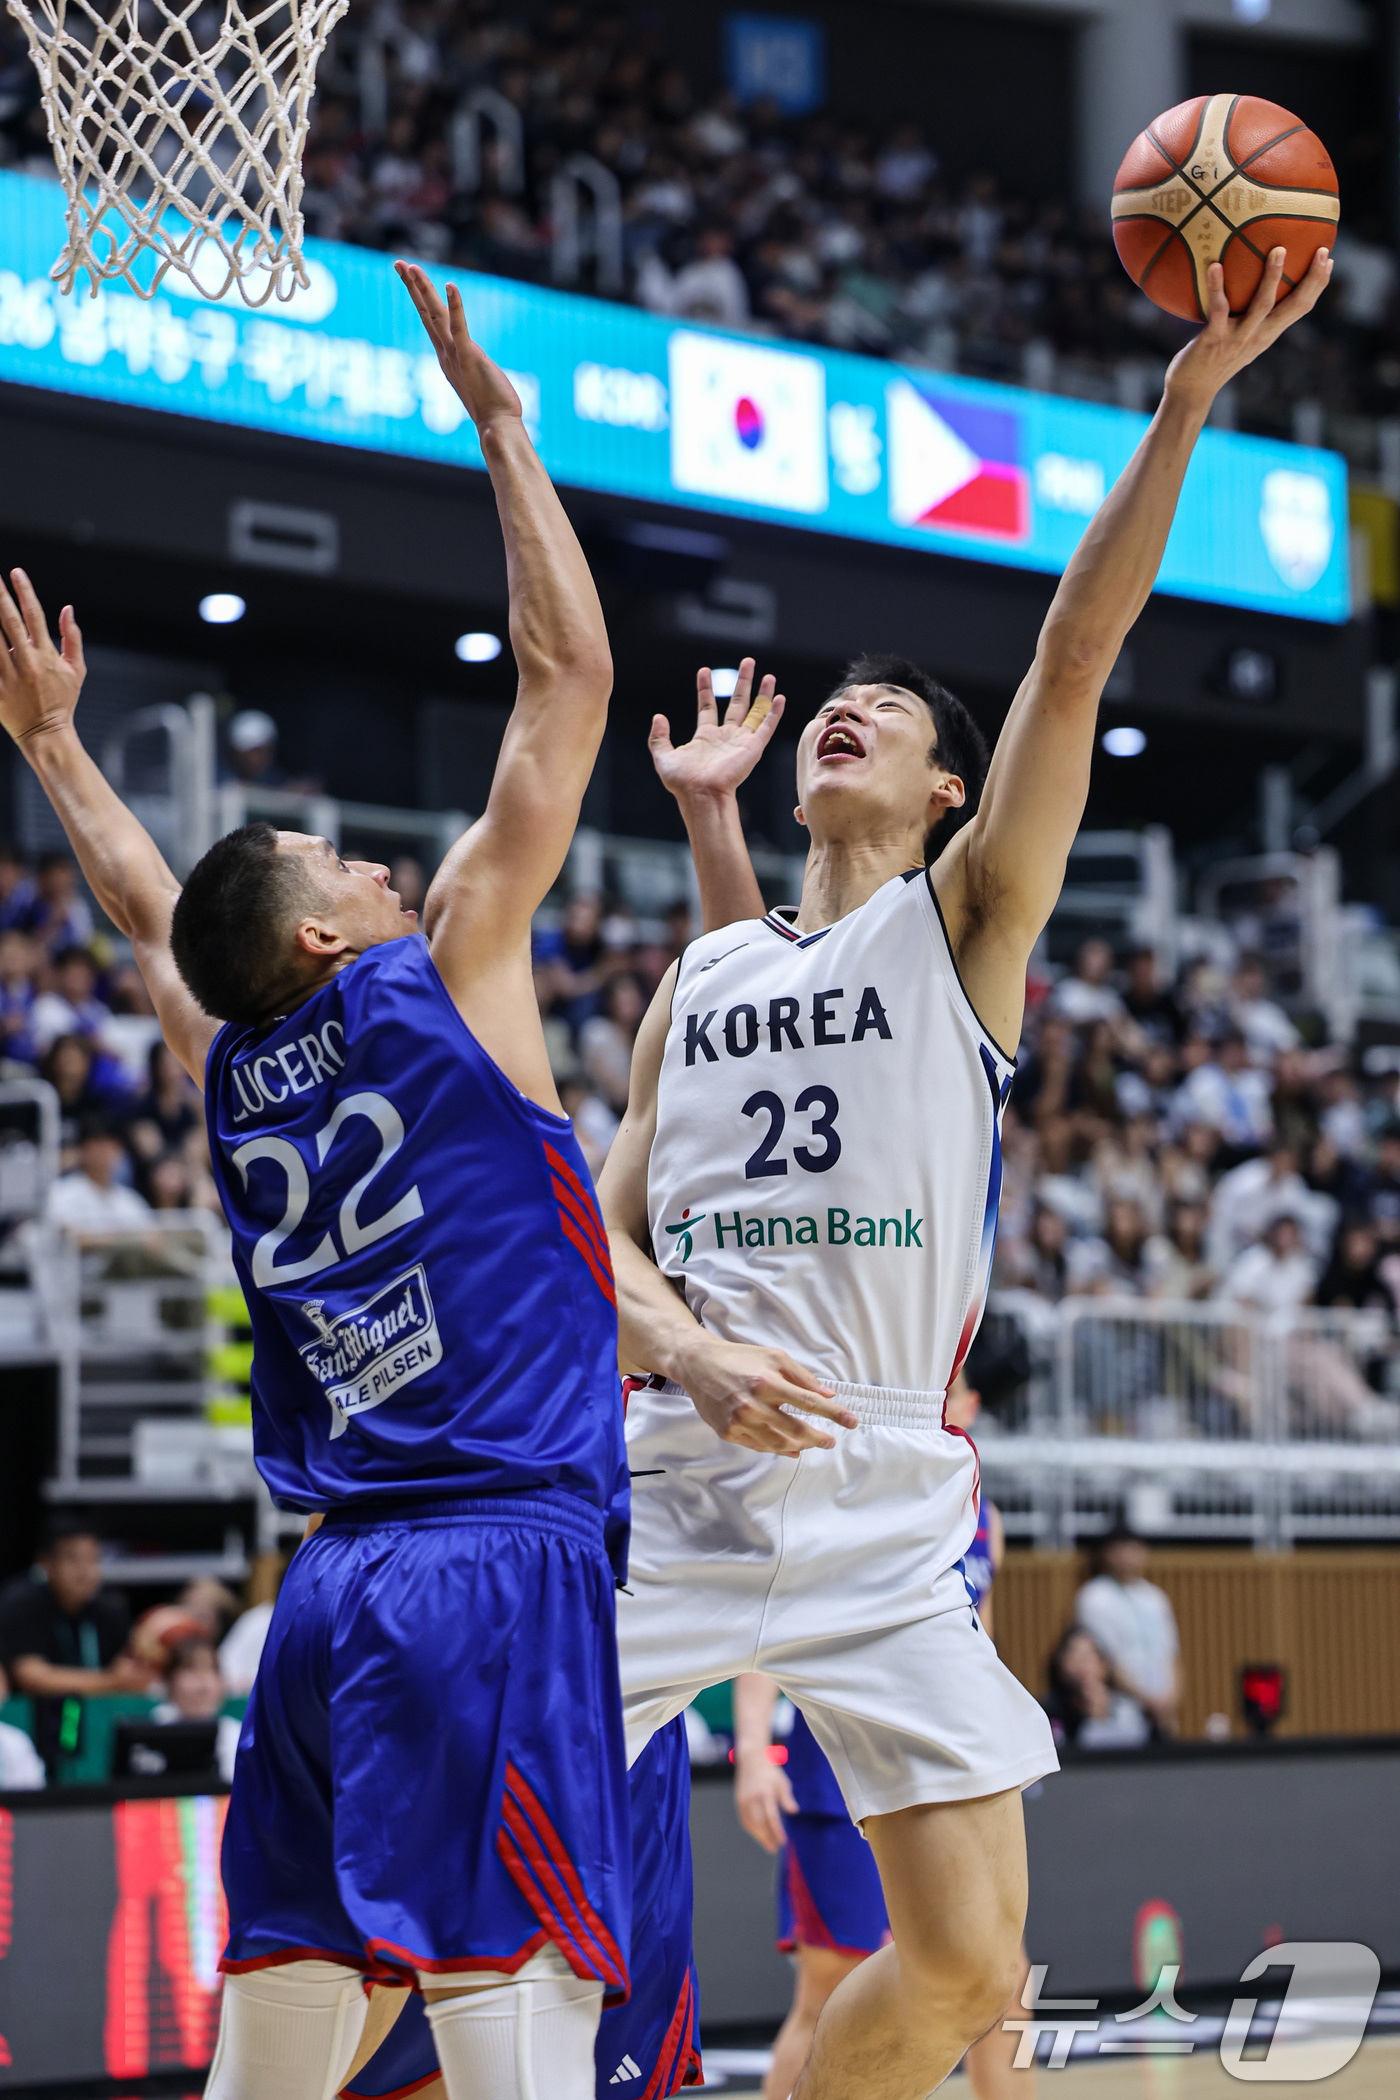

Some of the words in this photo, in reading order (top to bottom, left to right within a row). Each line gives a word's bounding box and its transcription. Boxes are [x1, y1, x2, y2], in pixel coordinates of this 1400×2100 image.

[1152, 188, 1192, 213] STEP
[683, 987, 893, 1067] KOREA
[741, 1085, 841, 1180] 23
[232, 1091, 424, 1288] 22
[714, 1211, 818, 1249] Hana
[828, 1208, 924, 1248] Bank
[372, 1340, 433, 1394] PILSEN
